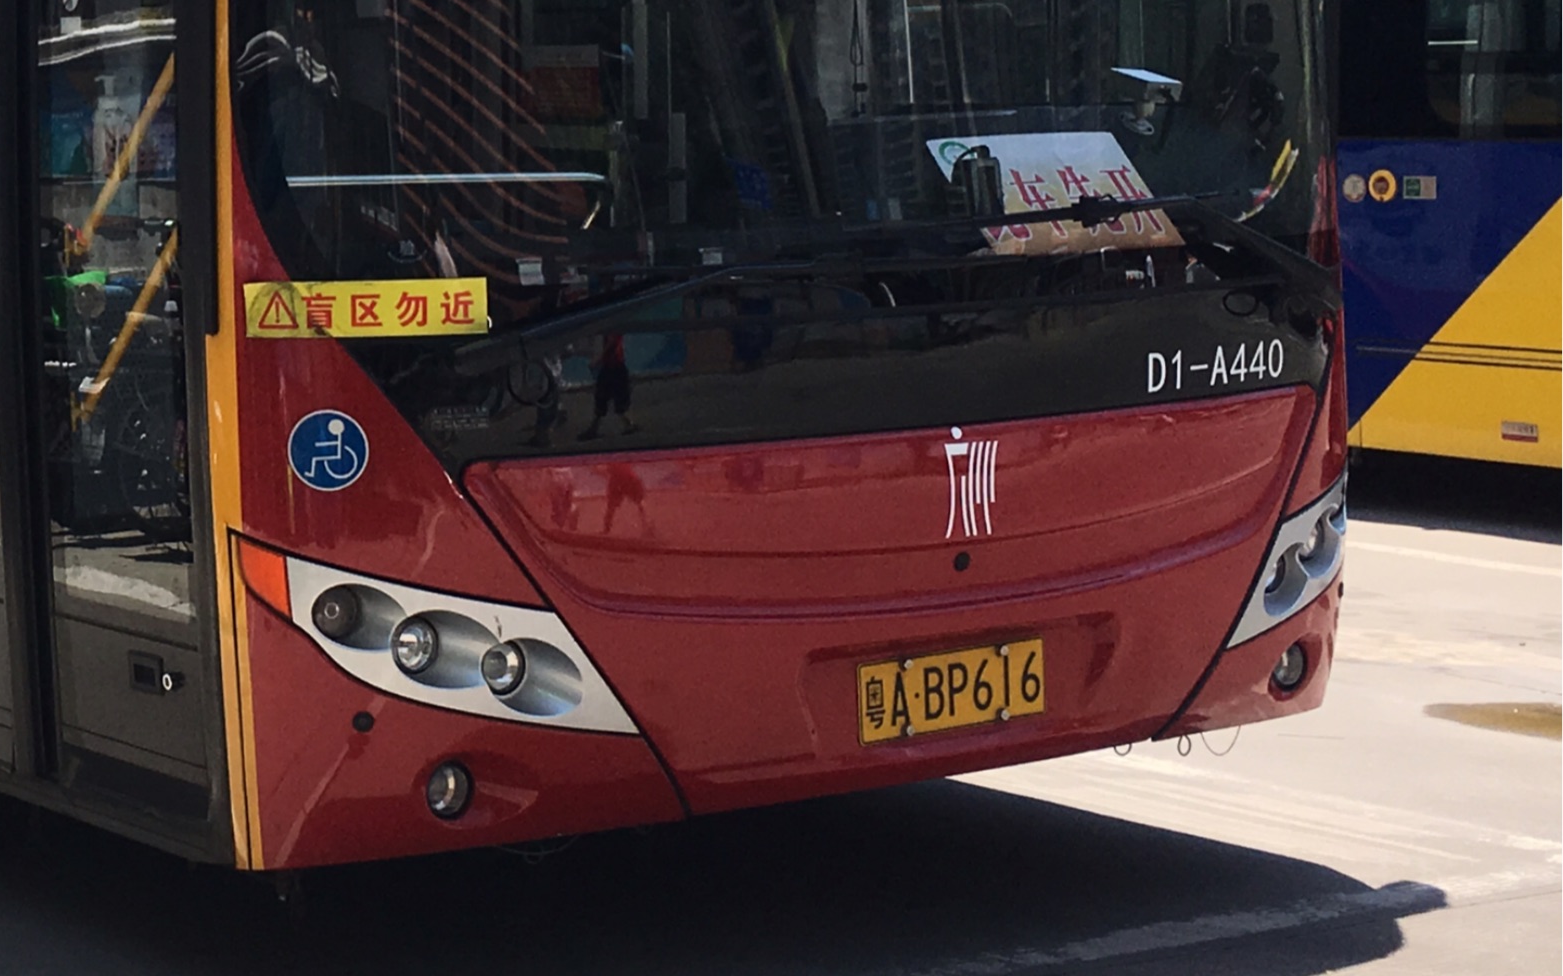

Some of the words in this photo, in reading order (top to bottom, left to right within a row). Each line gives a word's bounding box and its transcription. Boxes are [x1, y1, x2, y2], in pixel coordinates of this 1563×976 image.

[301, 290, 476, 330] 盲区勿近
[1145, 338, 1285, 394] D1-A440
